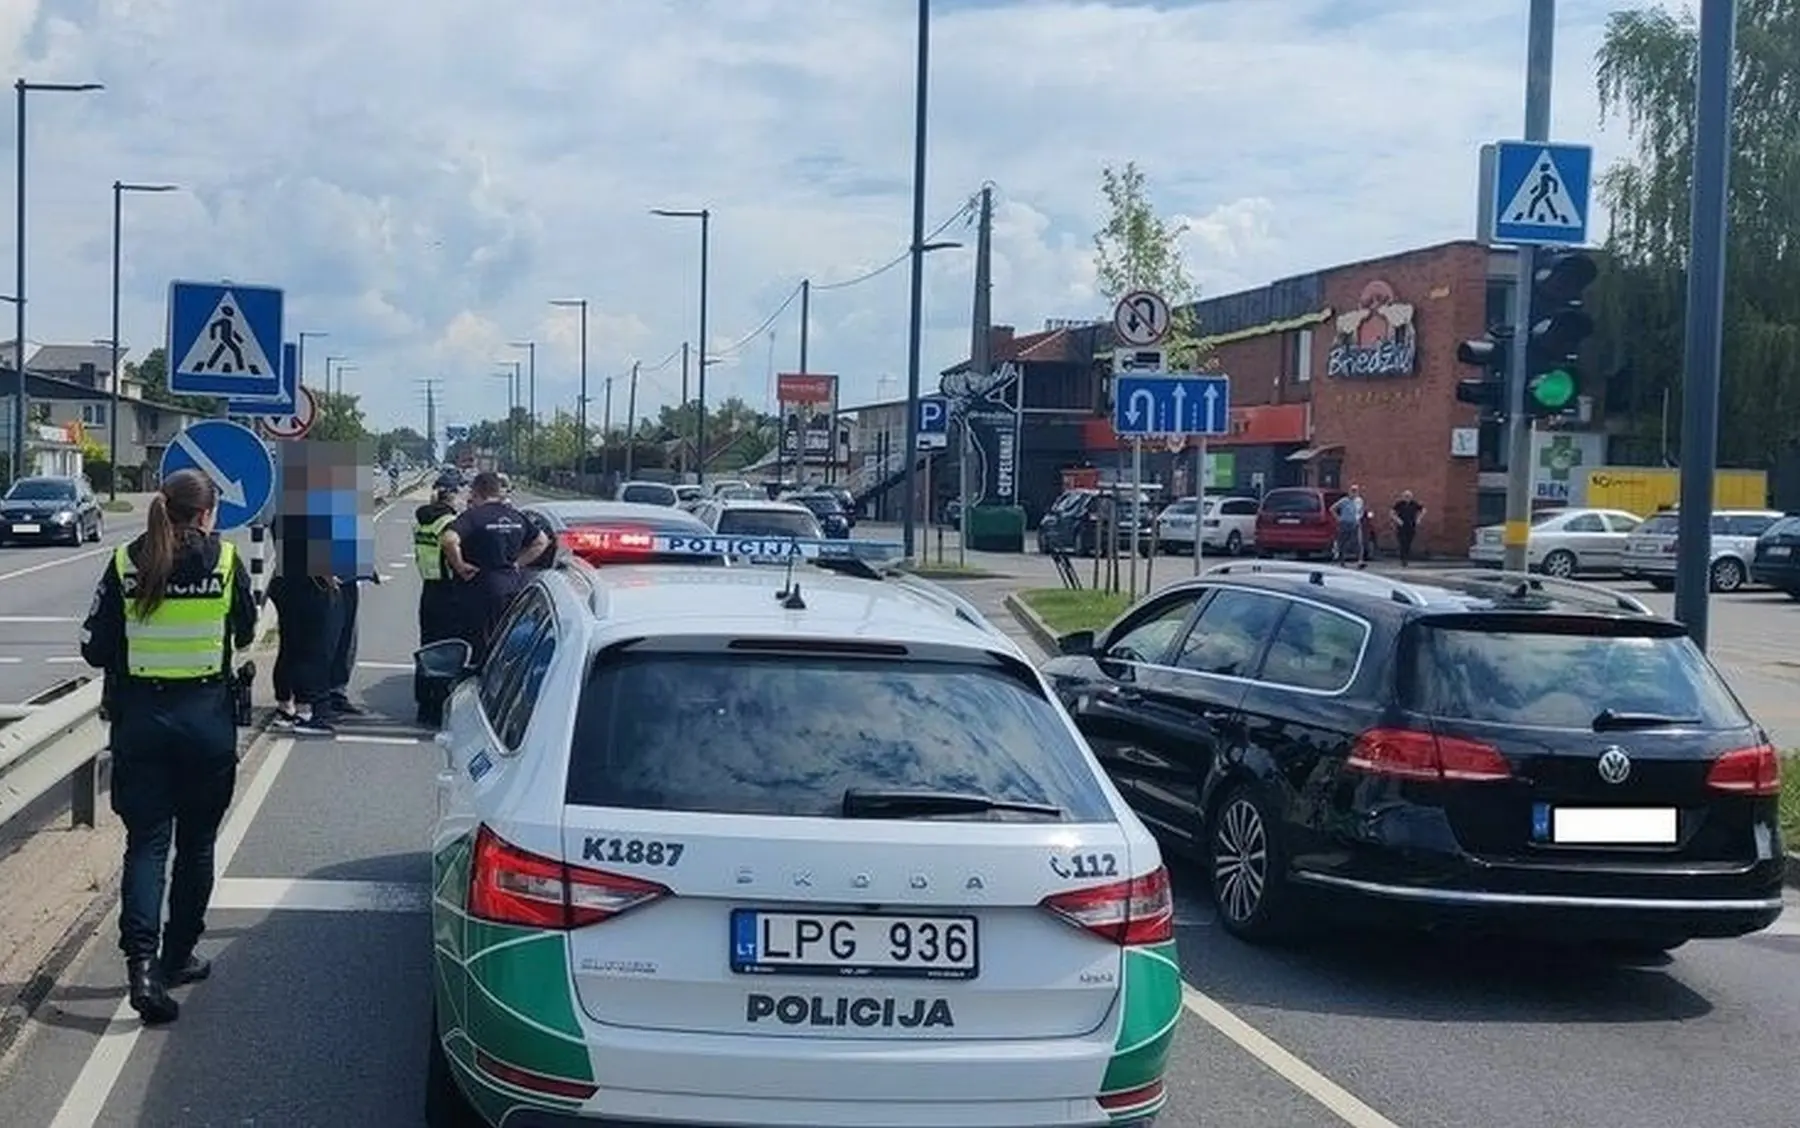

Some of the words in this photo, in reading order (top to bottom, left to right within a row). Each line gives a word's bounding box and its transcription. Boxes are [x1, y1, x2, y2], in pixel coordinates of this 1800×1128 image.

[921, 402, 941, 430] P
[669, 539, 802, 556] POLICIJA
[124, 577, 222, 594] PICIJA
[582, 837, 684, 866] K1887
[1071, 853, 1118, 878] 112
[737, 943, 755, 956] LT
[763, 918, 856, 960] LPG
[889, 922, 968, 962] 936
[747, 994, 954, 1028] POLICIJA
